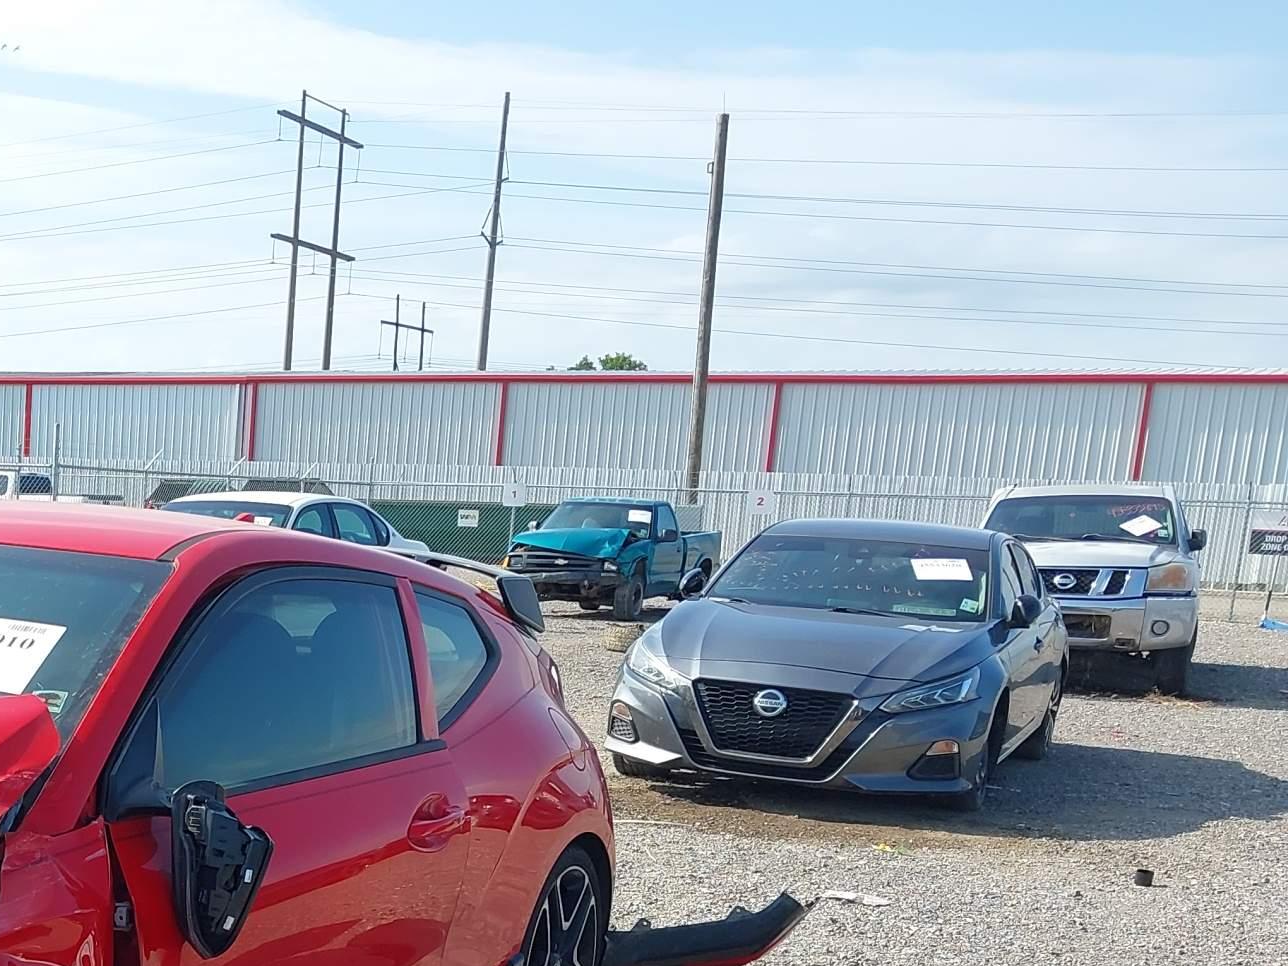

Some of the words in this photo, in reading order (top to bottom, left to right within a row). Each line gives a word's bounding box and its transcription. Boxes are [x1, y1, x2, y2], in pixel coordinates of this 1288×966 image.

[511, 490, 517, 499] 1
[756, 497, 765, 506] 2
[757, 699, 783, 707] NISSAN
